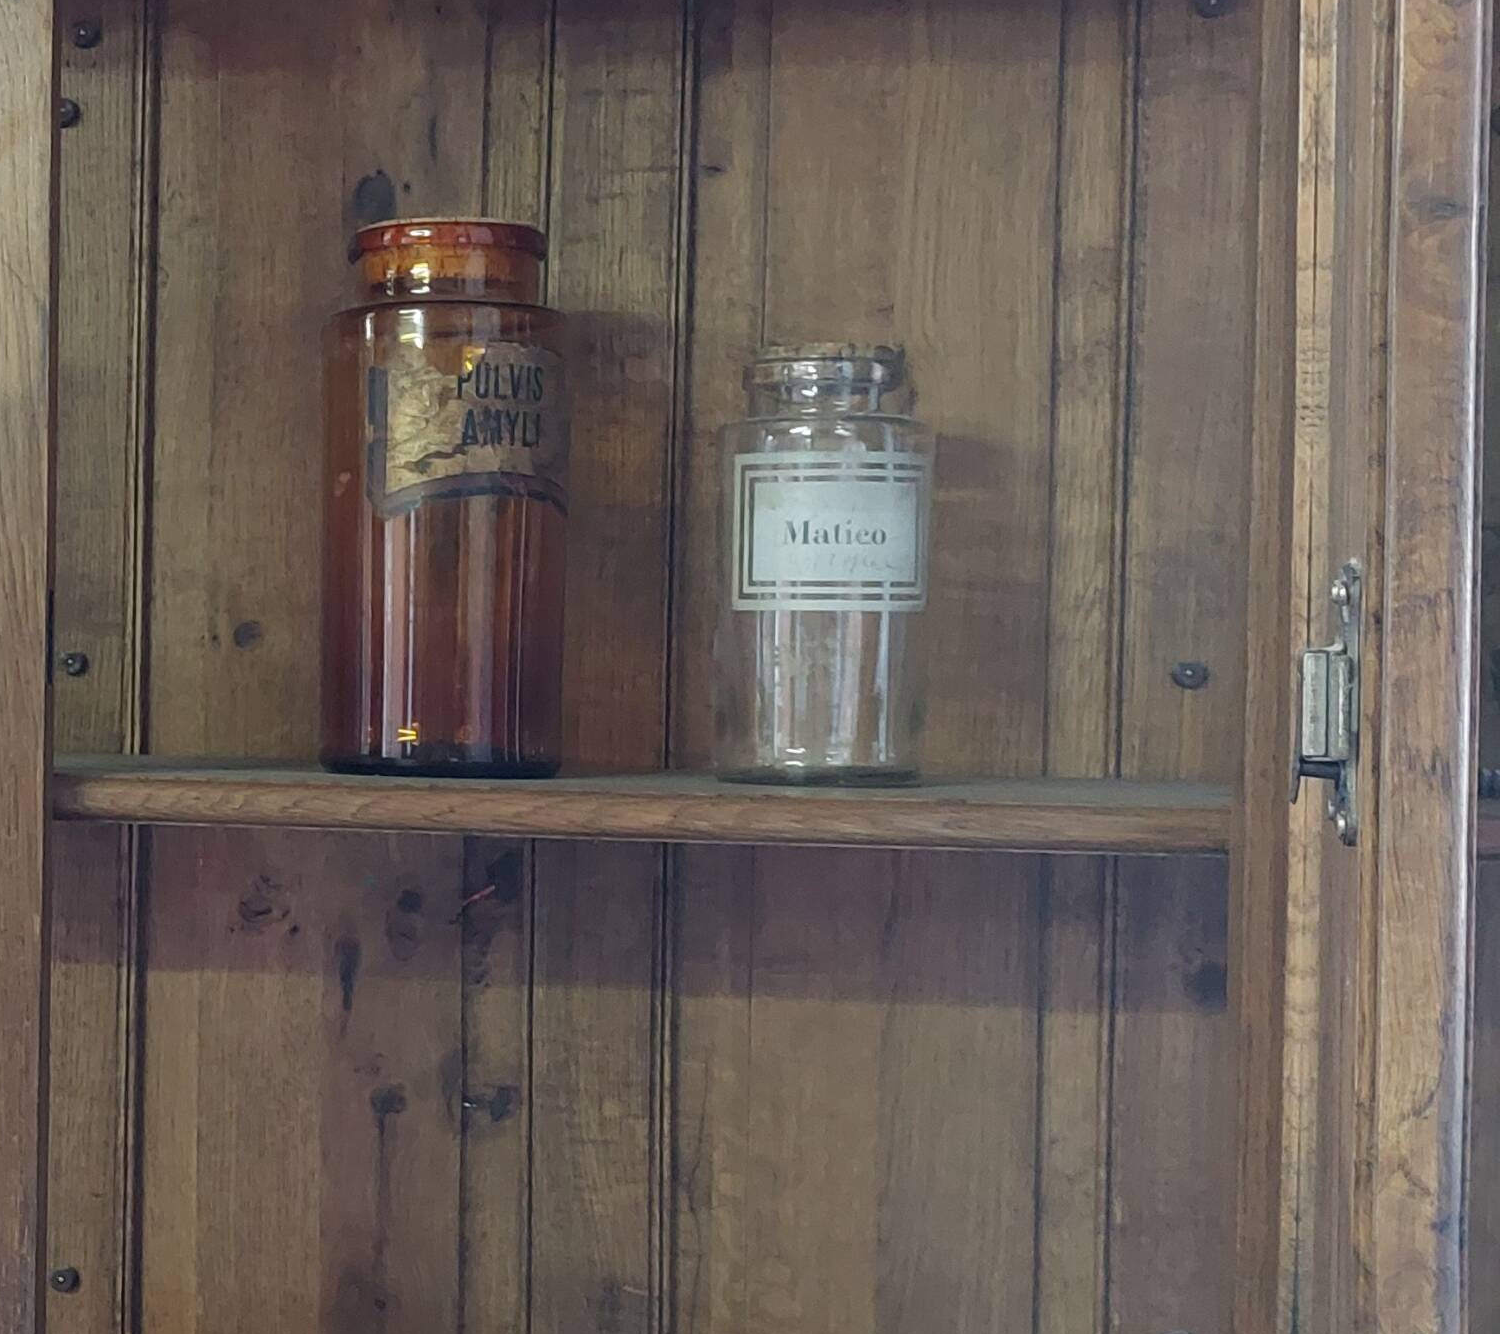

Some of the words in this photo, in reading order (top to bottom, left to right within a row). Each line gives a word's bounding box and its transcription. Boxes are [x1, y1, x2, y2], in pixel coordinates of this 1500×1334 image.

[457, 363, 543, 400] PULVIS
[462, 408, 541, 448] AMYLI
[783, 519, 887, 545] Matico
